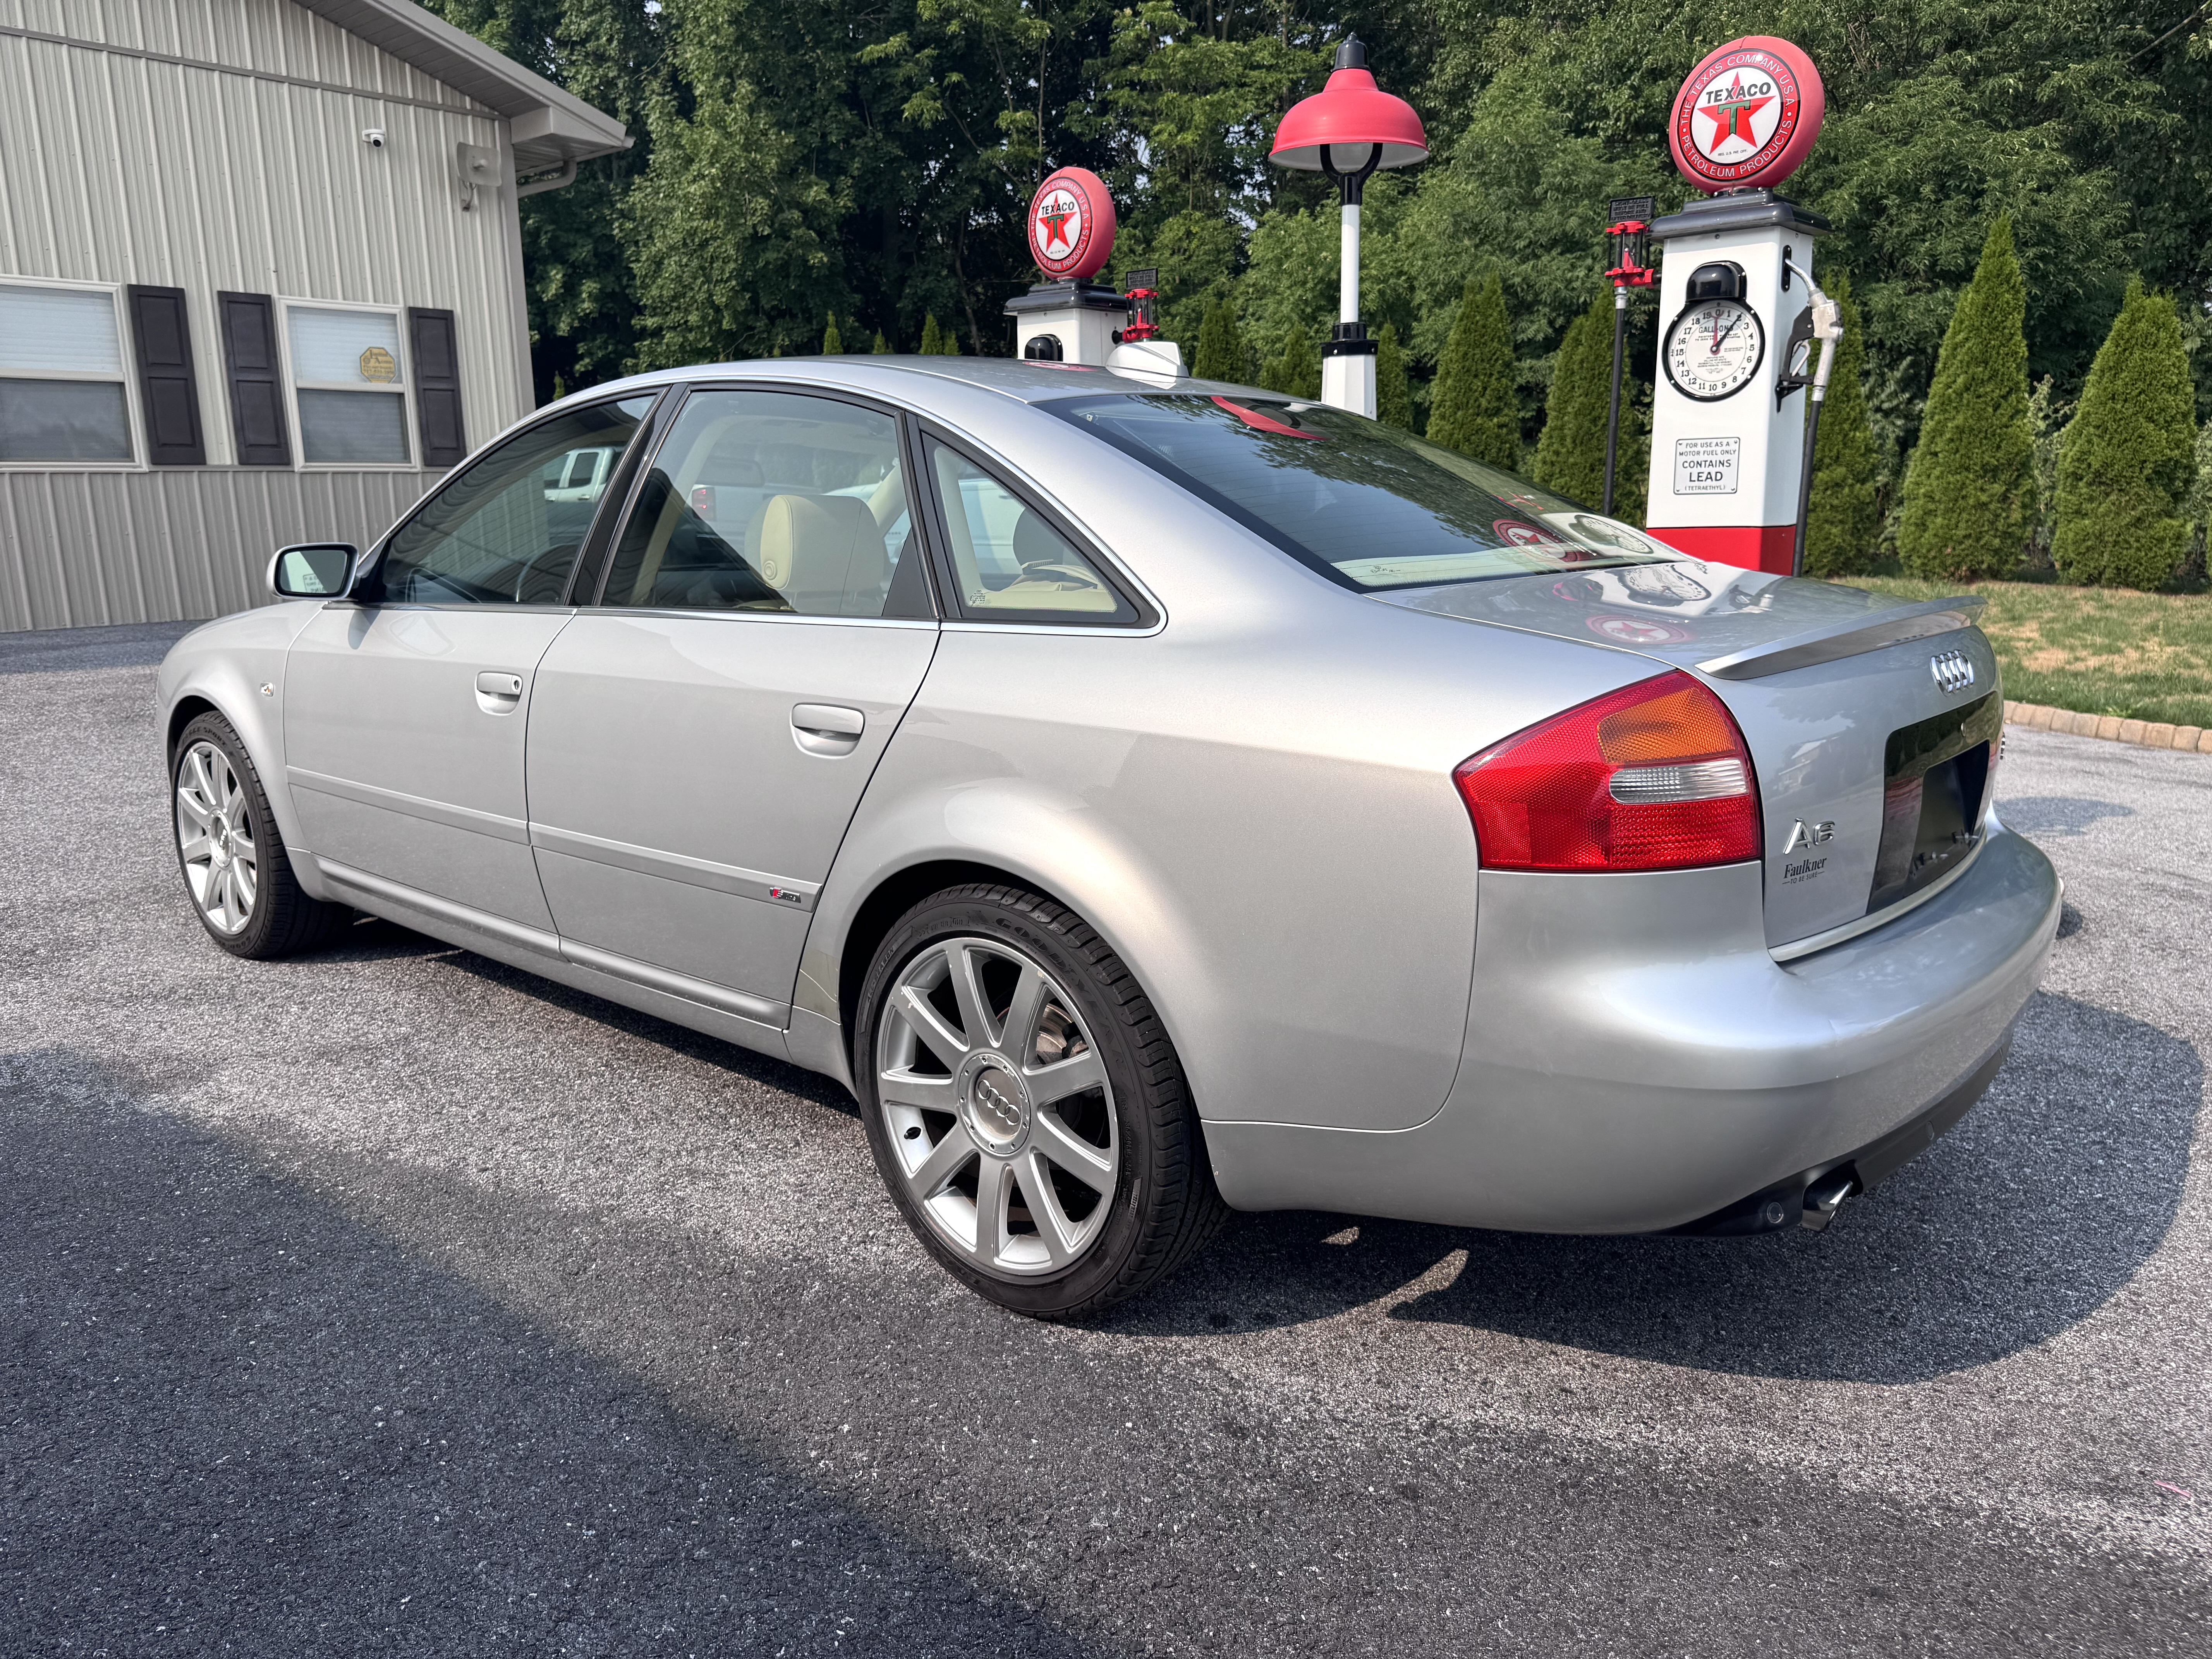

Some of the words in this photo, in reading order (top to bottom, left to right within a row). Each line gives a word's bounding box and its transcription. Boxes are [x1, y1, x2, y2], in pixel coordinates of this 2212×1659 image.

[1680, 100, 1693, 126] THE
[1690, 63, 1723, 94] TEXAS
[1727, 54, 1783, 74] COMPANY
[1706, 82, 1771, 104] TEXACO
[1717, 100, 1751, 135] T
[1681, 135, 1735, 177] PETROLEUM
[1740, 120, 1792, 175] PRODUCTS
[1052, 181, 1082, 196] COMPANY
[1041, 202, 1075, 216] TEXACO
[1063, 229, 1088, 267] PRODUCTS
[1702, 311, 1711, 319] 19
[1682, 459, 1731, 469] CONTAINS
[1689, 471, 1723, 482] LEAD
[1783, 818, 1835, 855] A6
[1783, 857, 1827, 879] Faulkner
[1806, 871, 1817, 880] SURE
